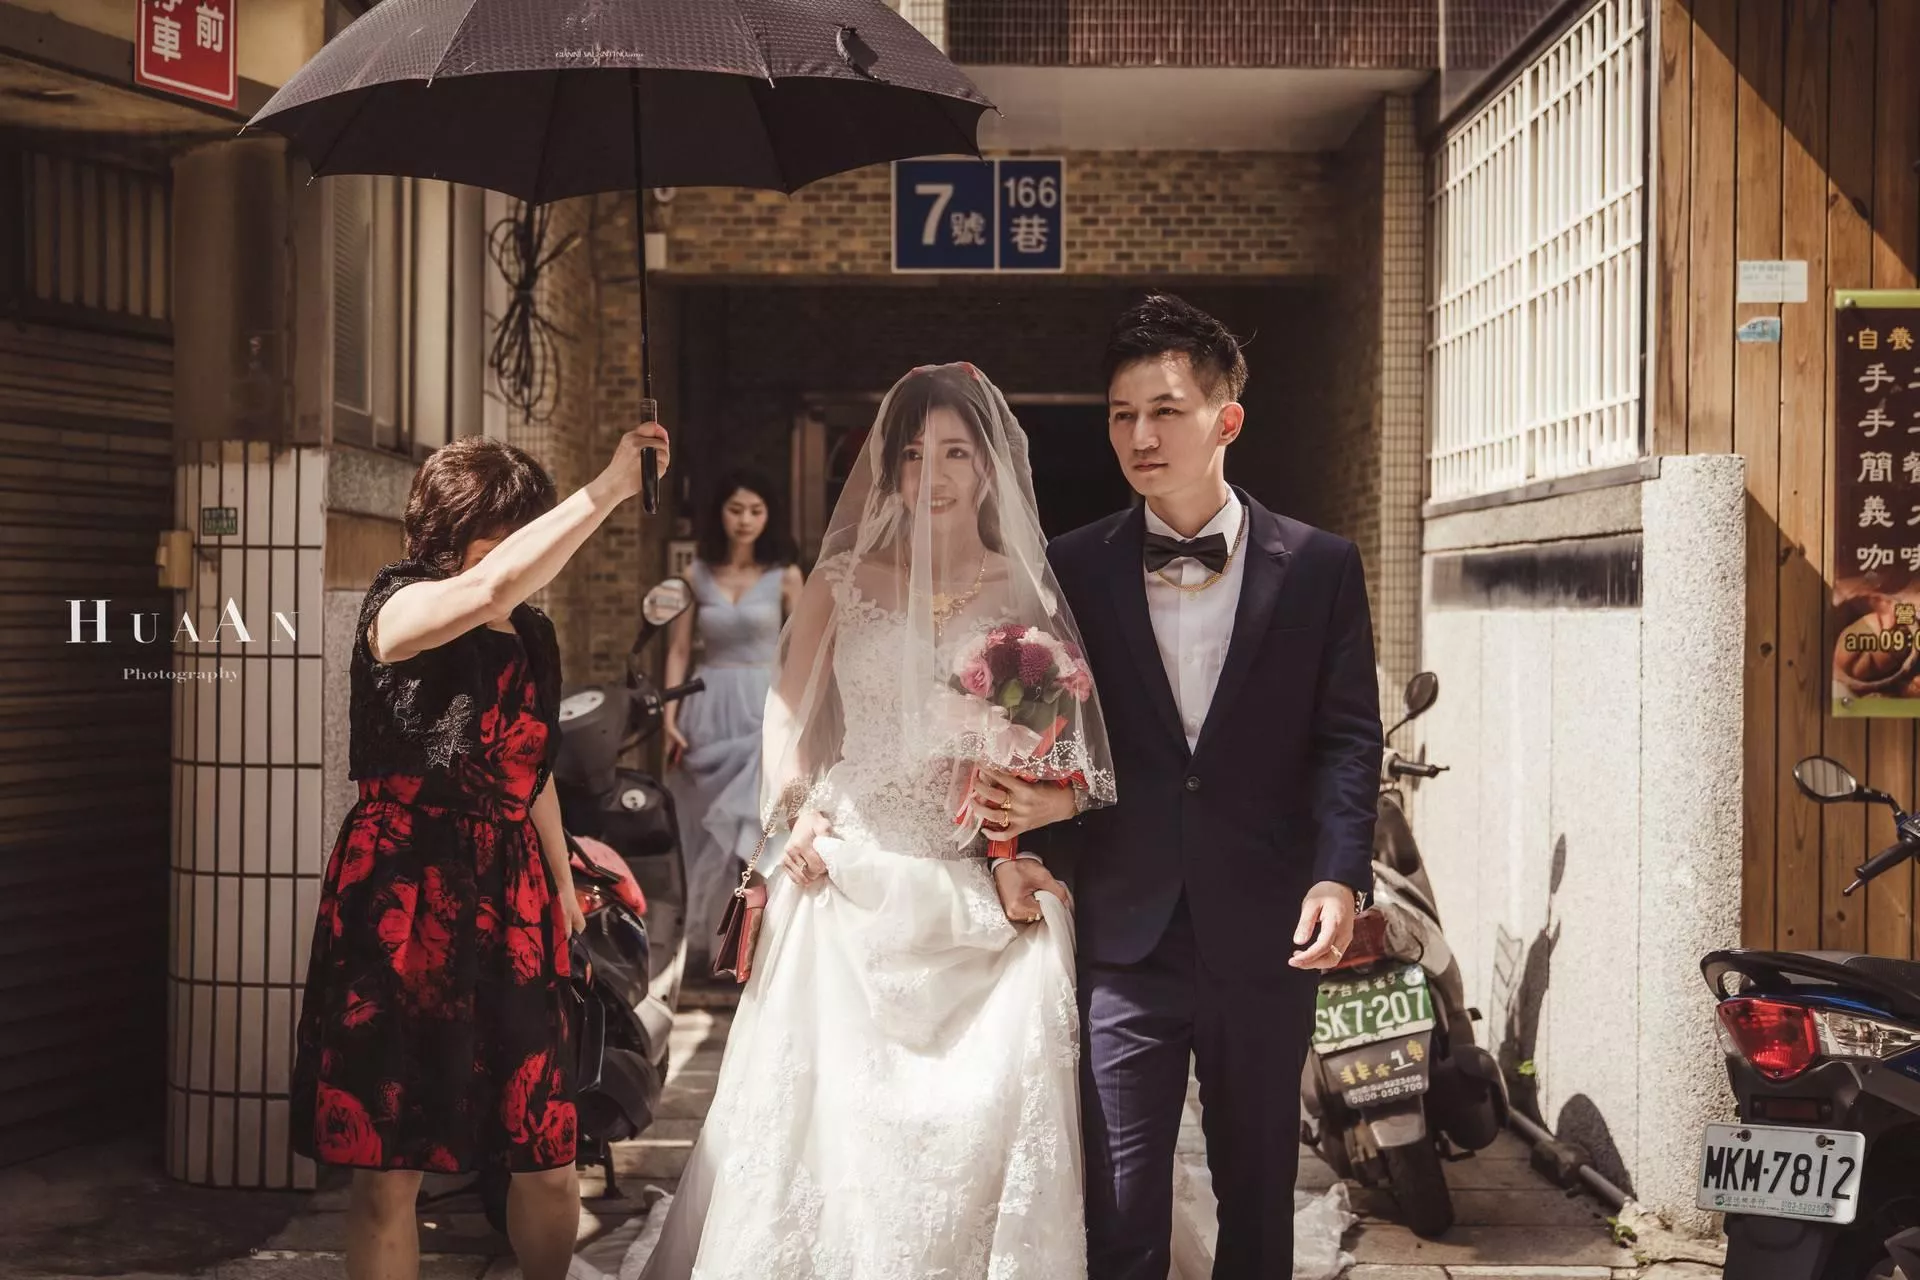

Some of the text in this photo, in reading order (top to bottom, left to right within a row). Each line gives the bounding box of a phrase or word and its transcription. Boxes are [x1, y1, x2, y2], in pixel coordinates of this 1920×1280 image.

[152, 0, 182, 62] 車
[196, 0, 225, 53] 前
[915, 184, 986, 246] 7號
[1004, 177, 1057, 209] 166
[1010, 214, 1049, 254] 巷
[1858, 326, 1914, 351] 自養
